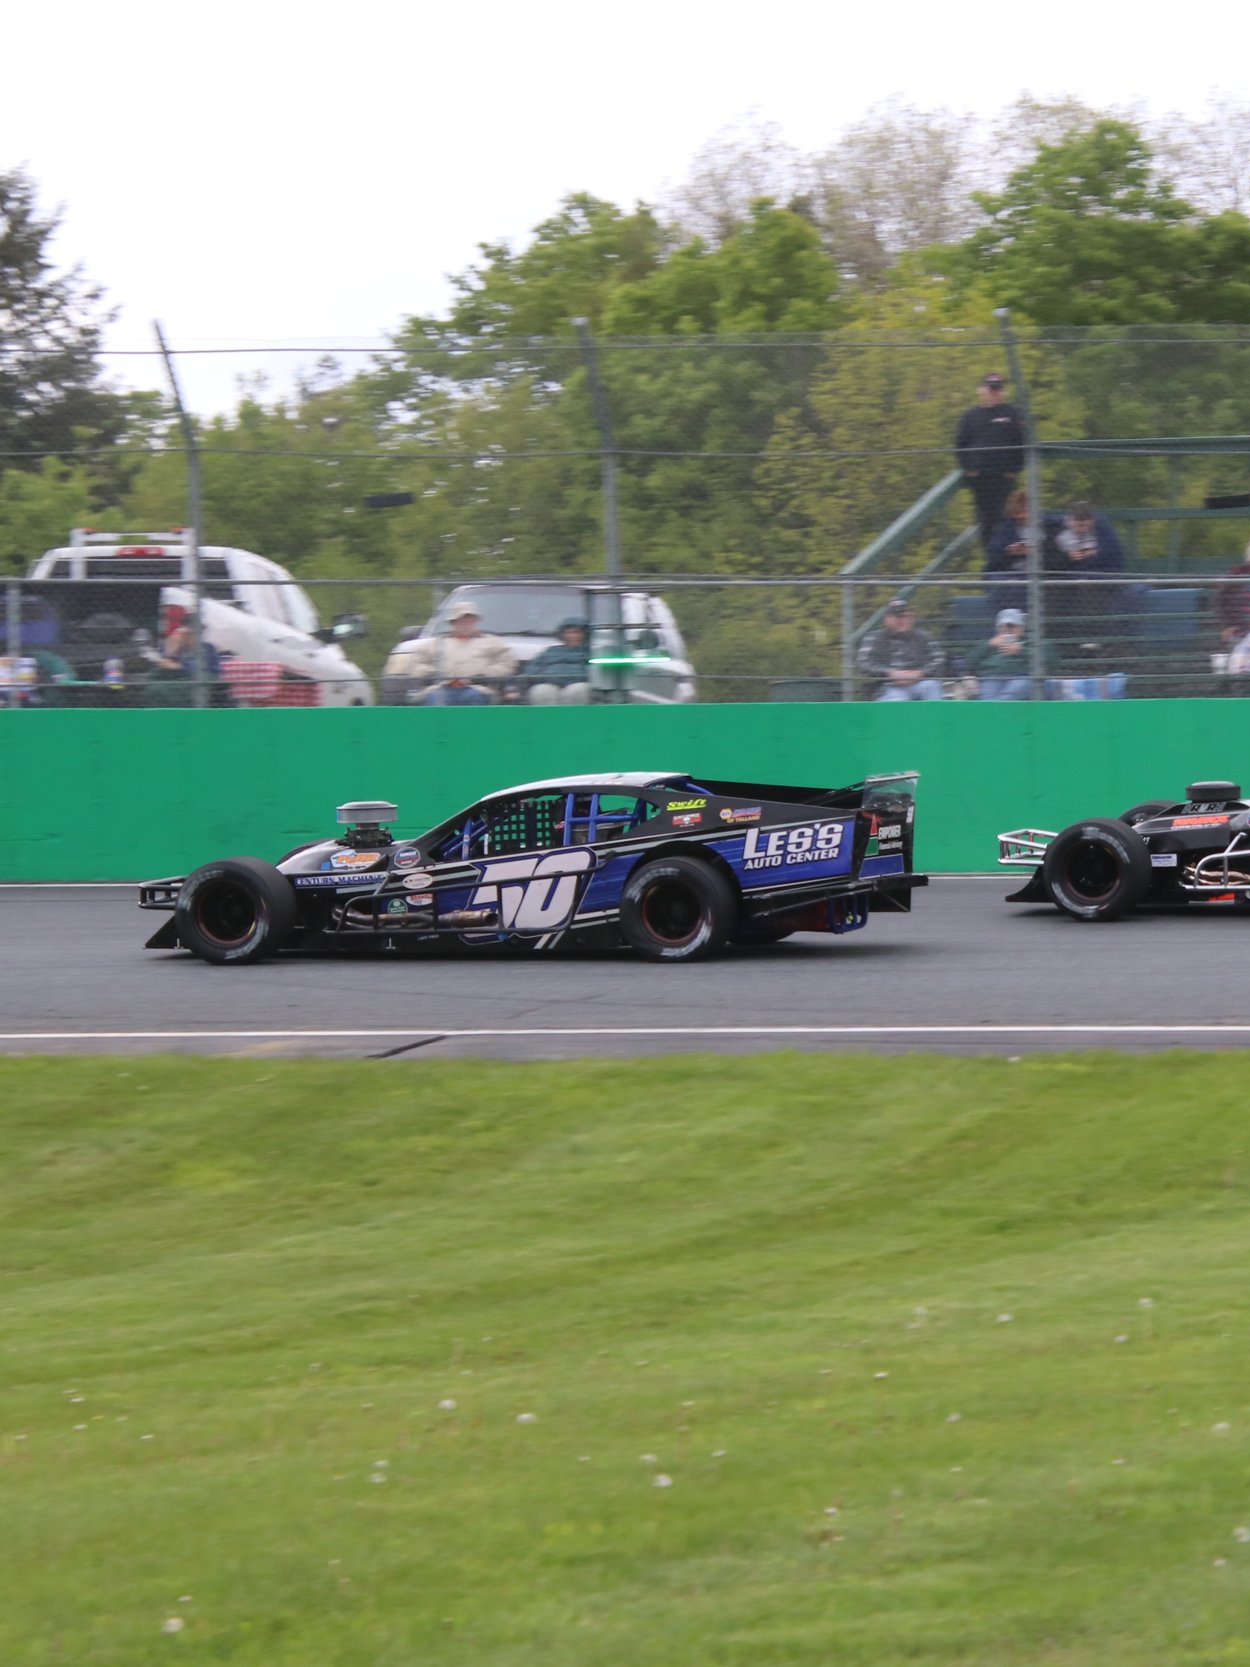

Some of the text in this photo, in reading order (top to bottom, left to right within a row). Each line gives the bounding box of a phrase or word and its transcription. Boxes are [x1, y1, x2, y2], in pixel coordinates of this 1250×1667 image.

[744, 847, 839, 870] AUTO CENTER
[464, 846, 597, 945] 50
